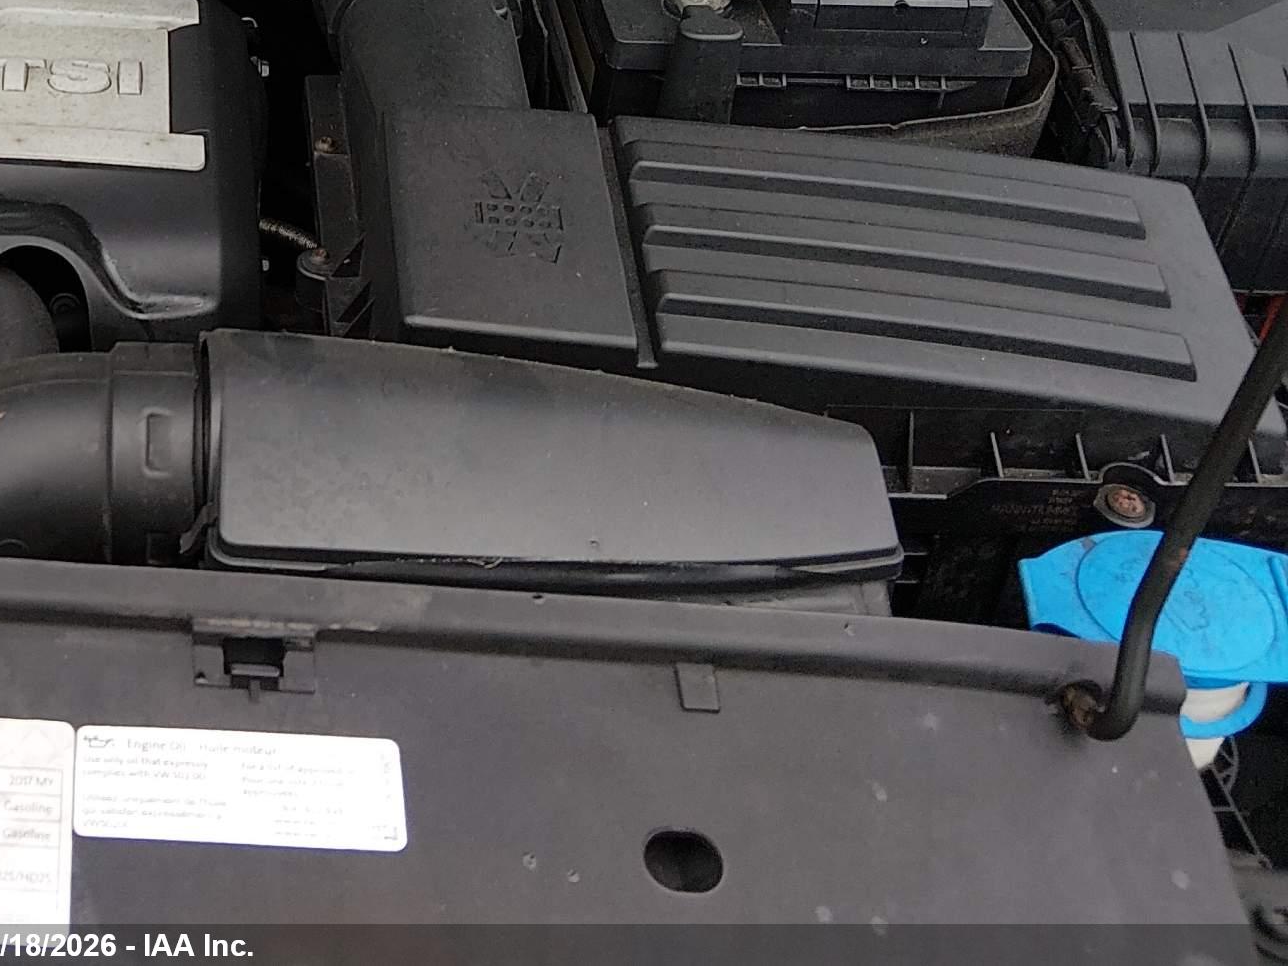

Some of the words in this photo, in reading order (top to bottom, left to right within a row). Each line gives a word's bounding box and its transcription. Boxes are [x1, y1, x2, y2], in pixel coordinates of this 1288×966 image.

[127, 738, 166, 753] Engine
[8, 774, 33, 786] 2017
[3, 800, 54, 815] Gasoline
